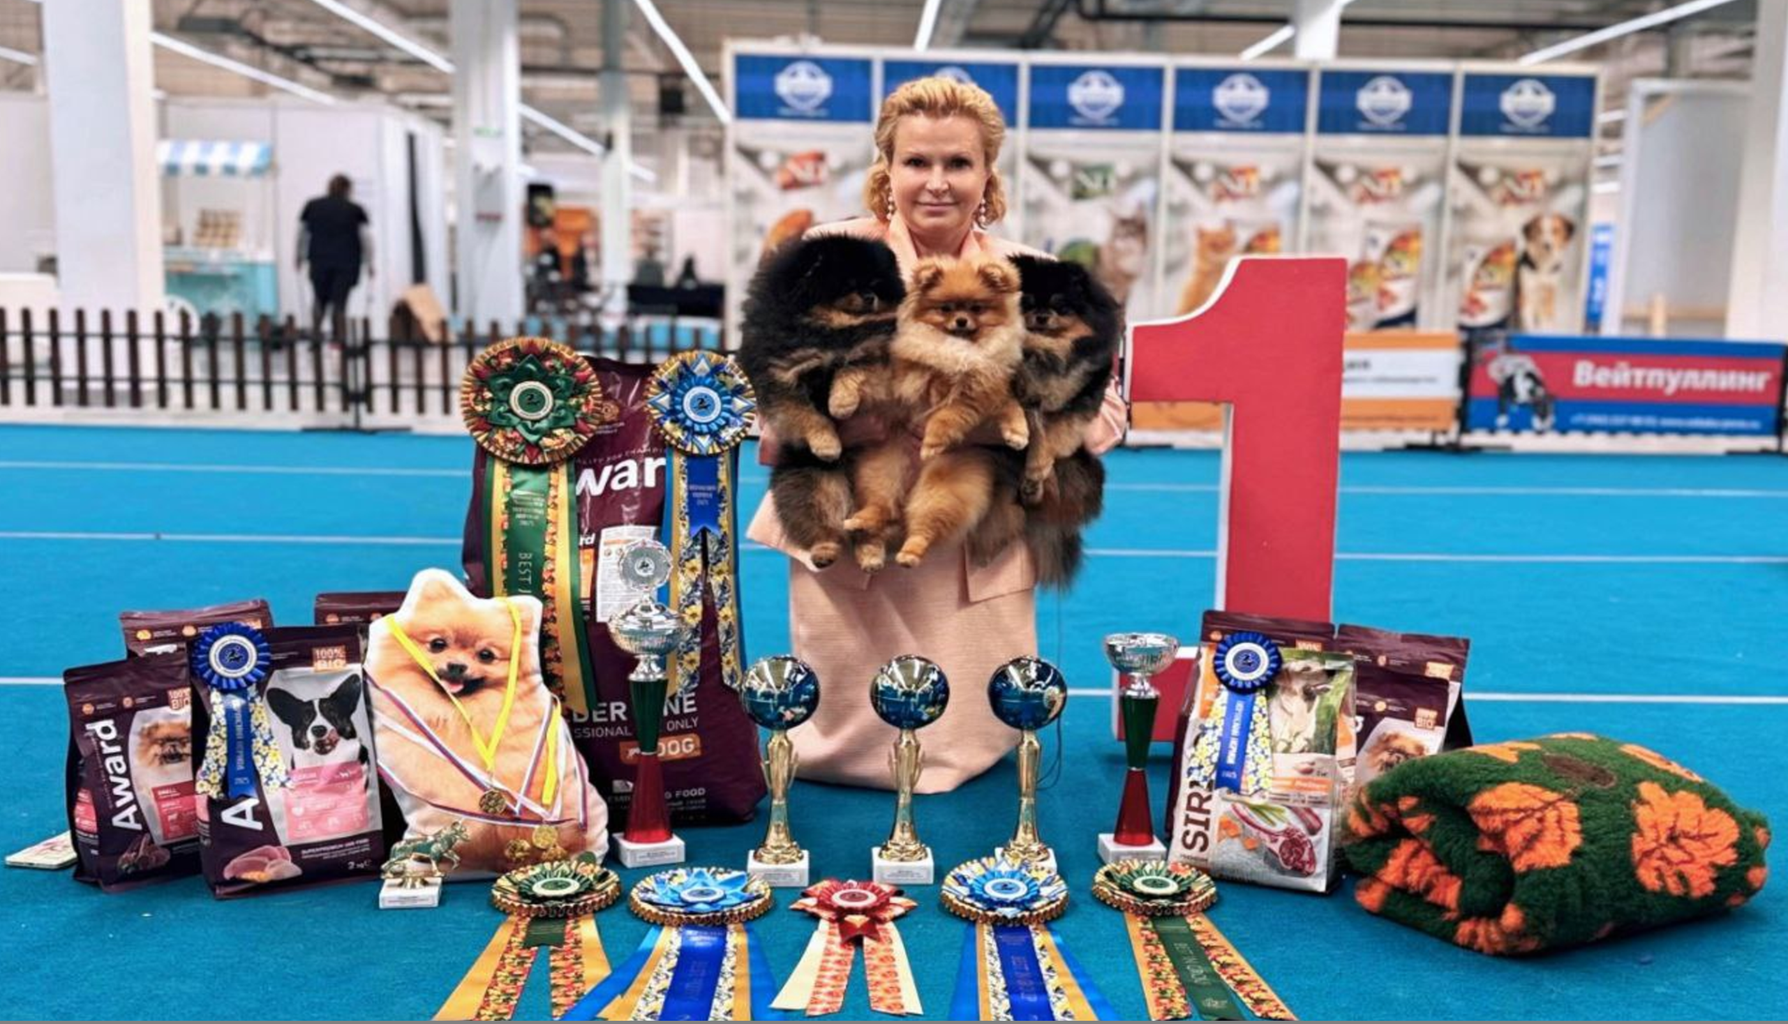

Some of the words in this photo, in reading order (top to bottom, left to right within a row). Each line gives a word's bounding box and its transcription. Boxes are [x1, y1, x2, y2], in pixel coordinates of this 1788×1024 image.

[1573, 359, 1772, 396] Вейтпуллинг
[518, 552, 533, 585] BEST
[315, 647, 345, 658] 100%
[667, 717, 699, 732] ONLY
[85, 719, 143, 831] Award
[675, 787, 706, 799] FOOD
